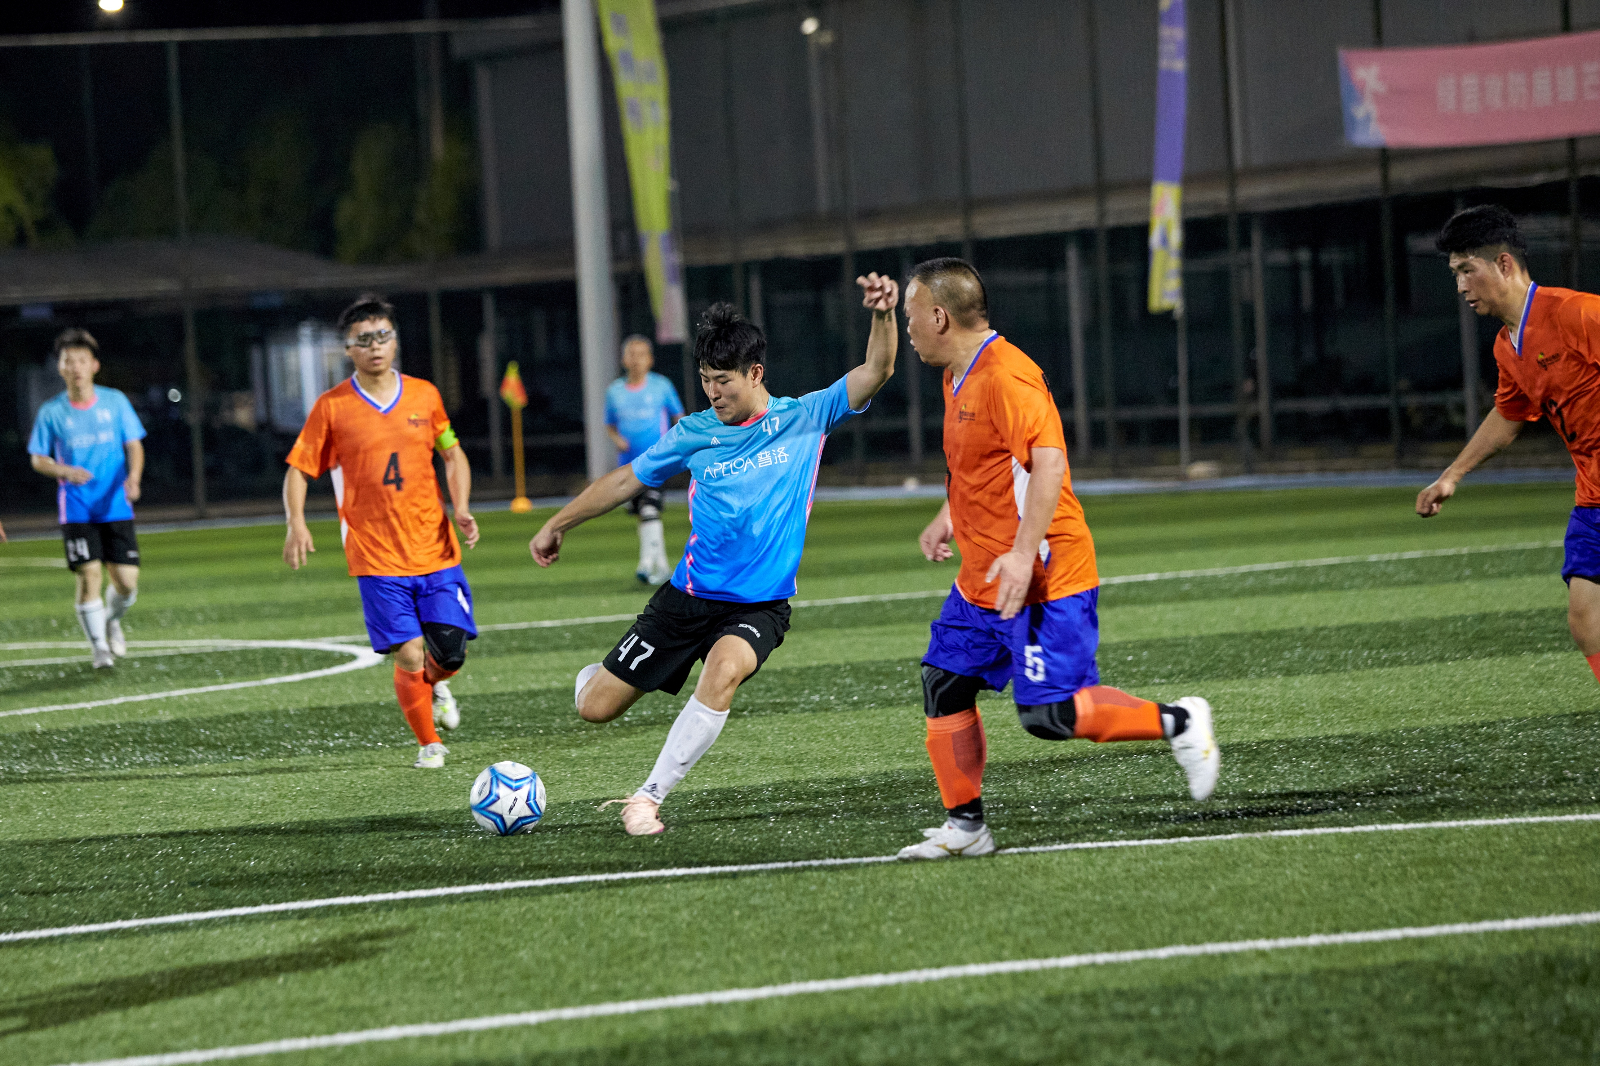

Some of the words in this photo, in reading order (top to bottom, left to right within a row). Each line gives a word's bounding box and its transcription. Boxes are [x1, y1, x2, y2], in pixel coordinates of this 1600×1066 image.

[762, 416, 780, 436] 47
[382, 452, 404, 491] 4
[703, 456, 757, 480] APELOA
[757, 446, 790, 468] 普洛
[617, 632, 656, 671] 47
[1023, 644, 1047, 683] 5
